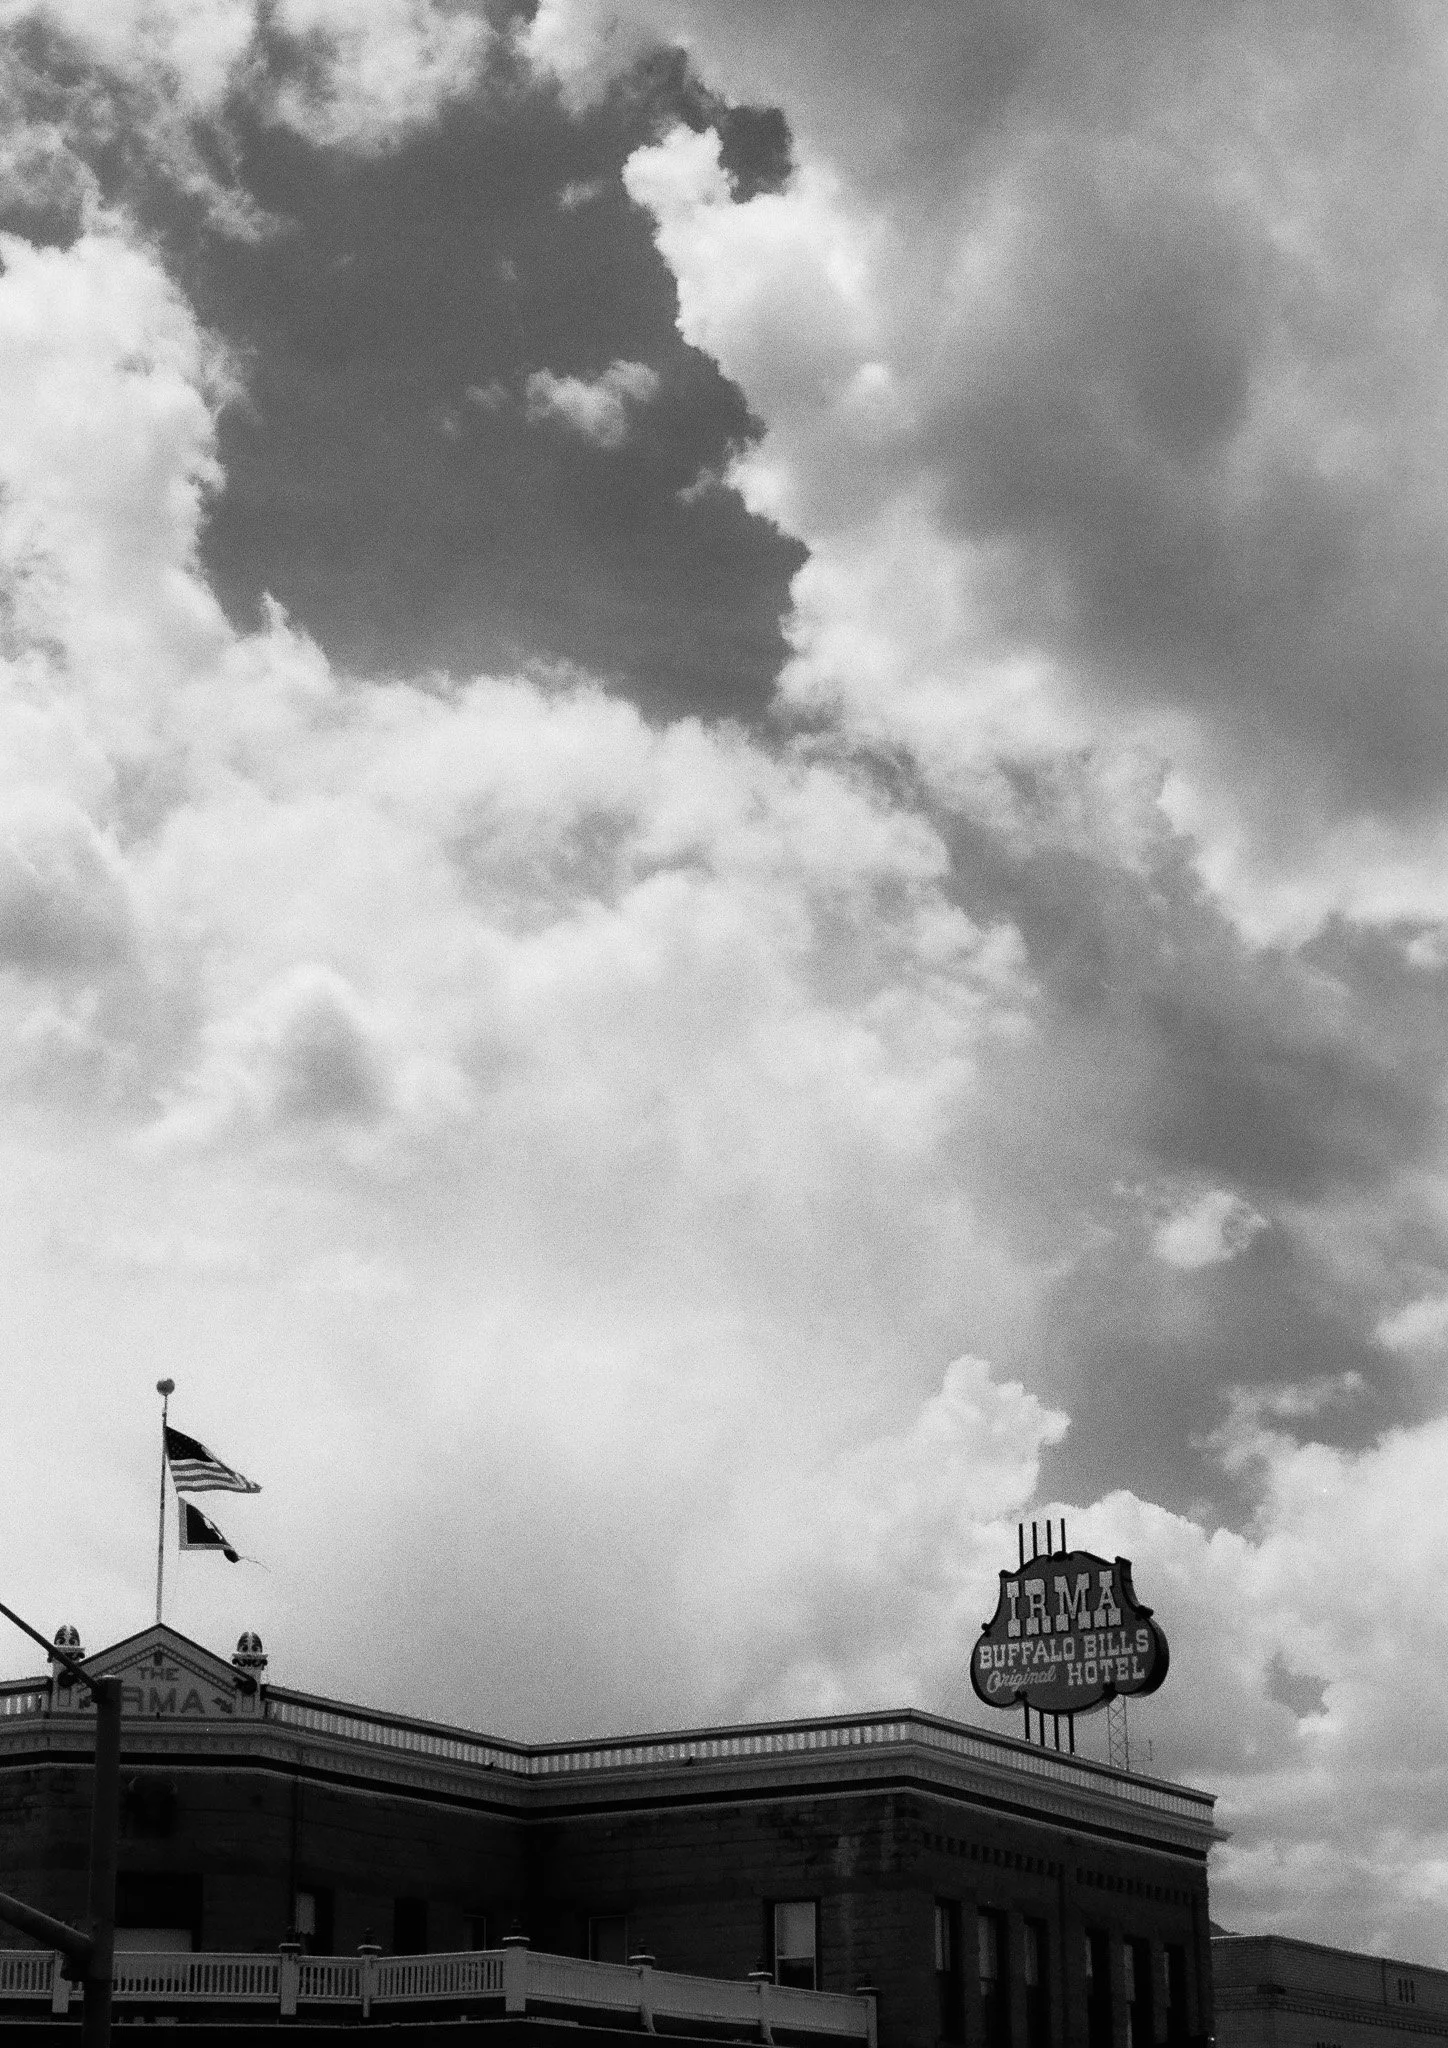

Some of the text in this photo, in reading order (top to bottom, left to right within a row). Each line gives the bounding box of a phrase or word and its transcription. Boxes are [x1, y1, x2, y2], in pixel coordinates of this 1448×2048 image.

[1006, 1570, 1122, 1637] IRMA
[979, 1636, 1076, 1670] BUFFALO
[137, 1667, 180, 1681] THE
[986, 1656, 1146, 1693] Original HOTEL
[119, 1685, 206, 1714] RMA
